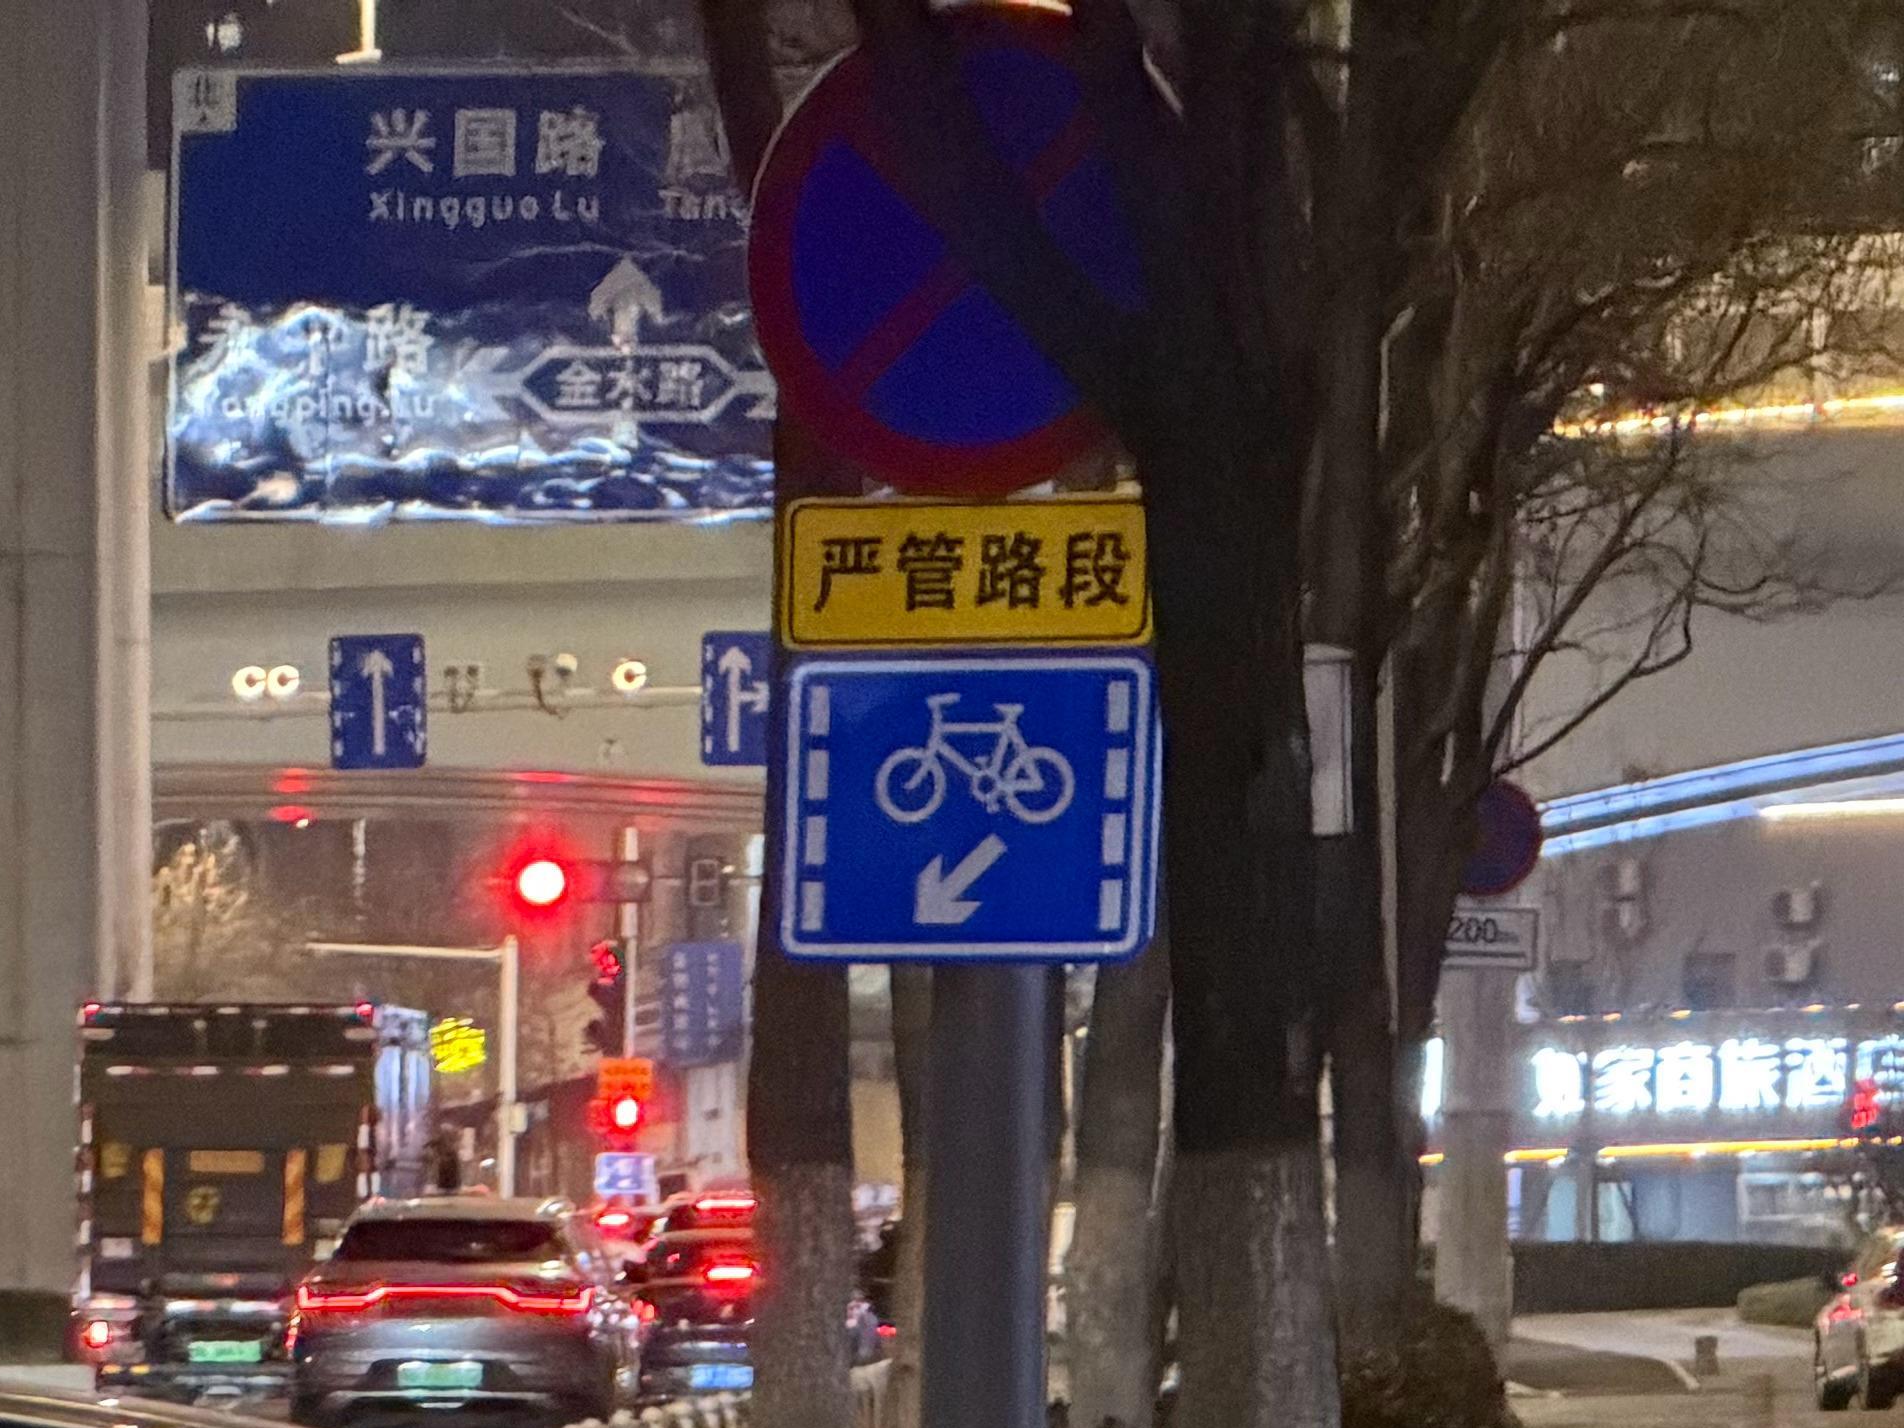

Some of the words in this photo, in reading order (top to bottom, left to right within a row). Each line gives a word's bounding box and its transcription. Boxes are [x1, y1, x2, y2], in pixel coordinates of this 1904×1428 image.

[364, 106, 604, 178] 兴国路
[369, 190, 540, 230] Xingguo
[198, 386, 386, 426] ongping
[555, 359, 704, 406] 金水路
[812, 531, 1132, 613] 严管路段
